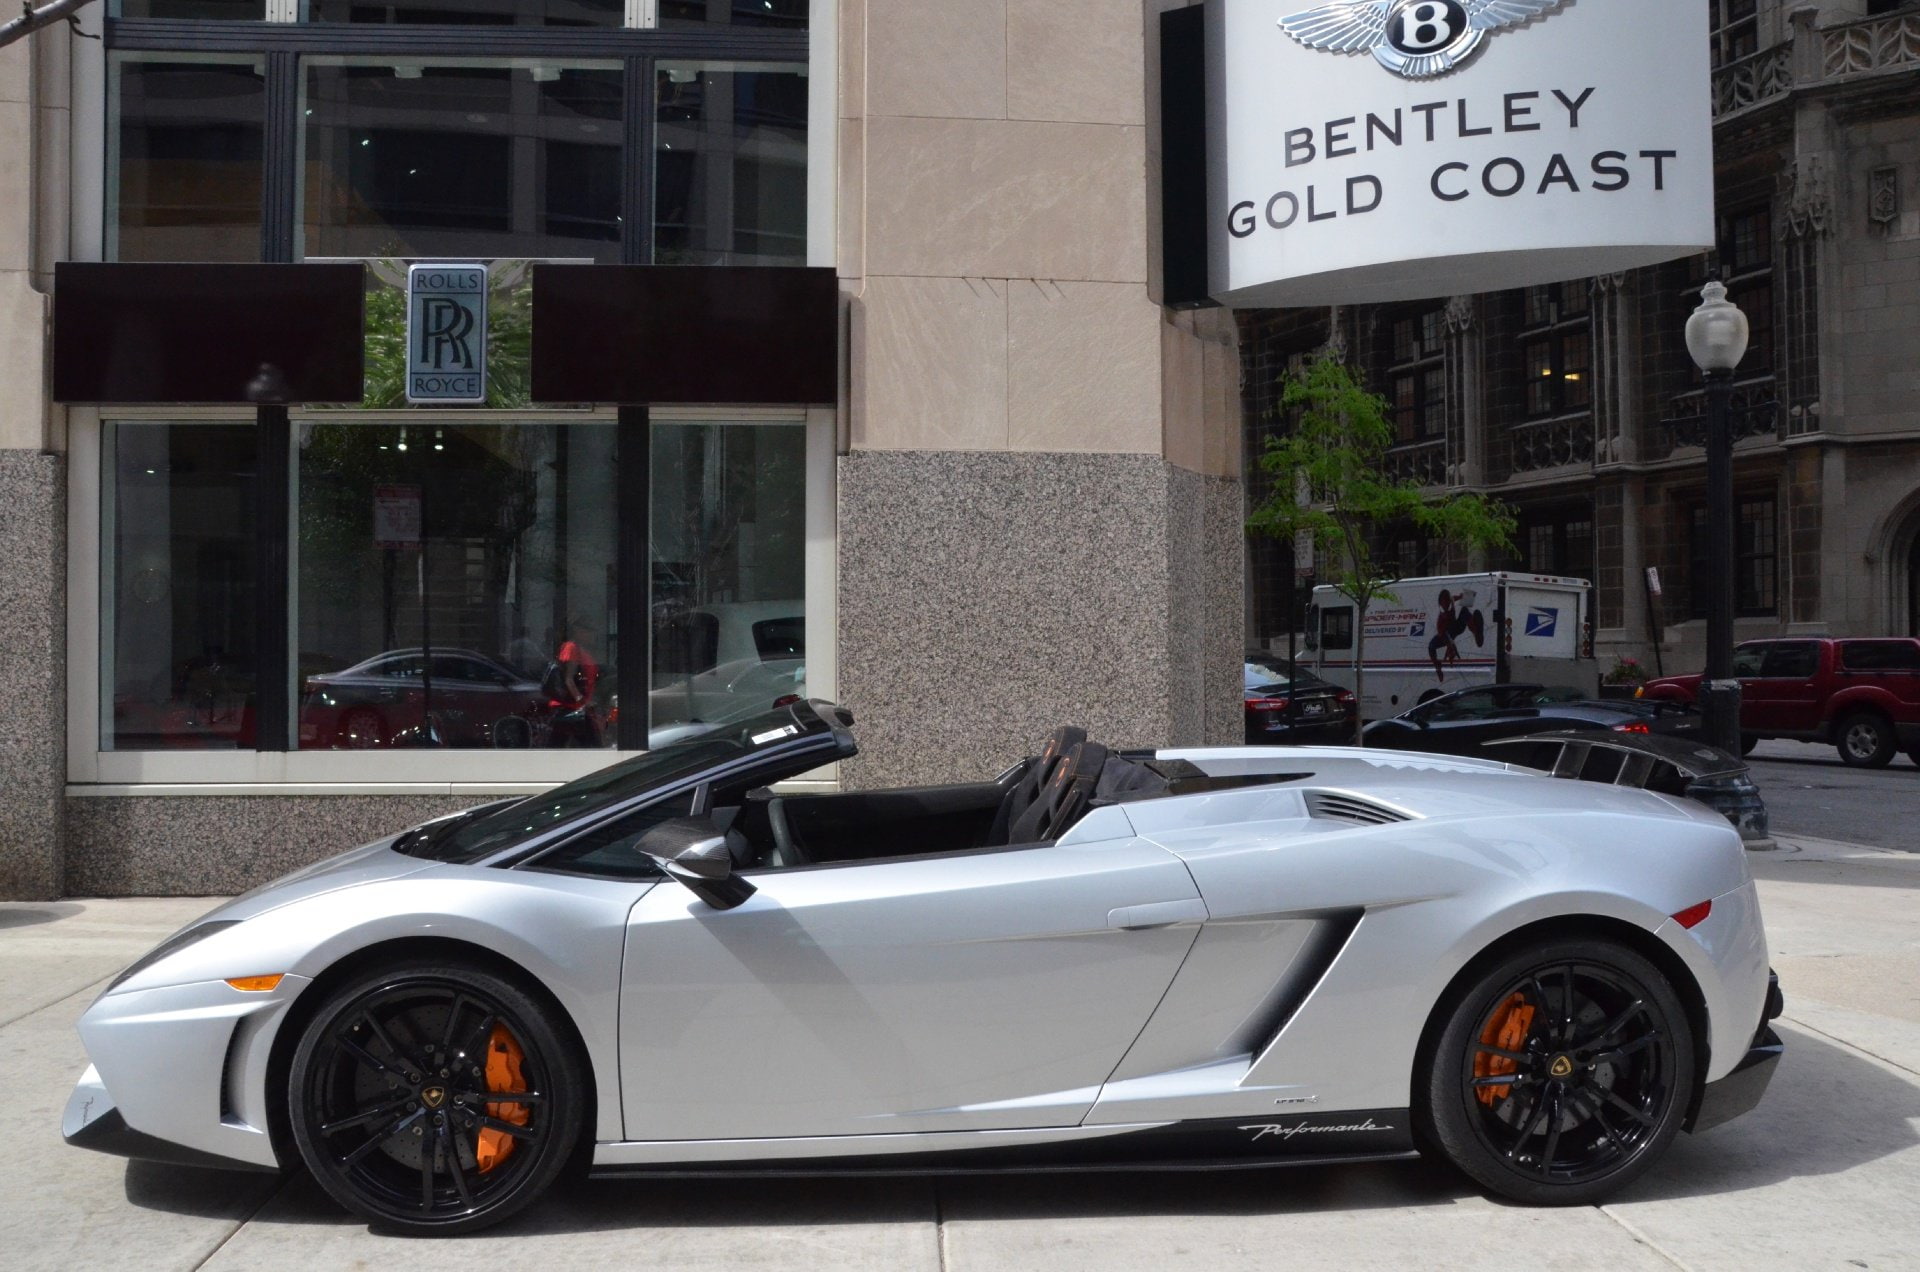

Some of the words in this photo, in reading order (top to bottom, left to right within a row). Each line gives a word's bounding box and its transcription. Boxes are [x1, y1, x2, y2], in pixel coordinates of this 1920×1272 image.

[1284, 87, 1596, 168] BENTLEY
[1227, 174, 1383, 239] GOLD
[1430, 150, 1677, 202] COAST
[416, 273, 478, 289] ROLLS
[414, 377, 476, 393] ROYCE
[1237, 1118, 1394, 1142] Performante
